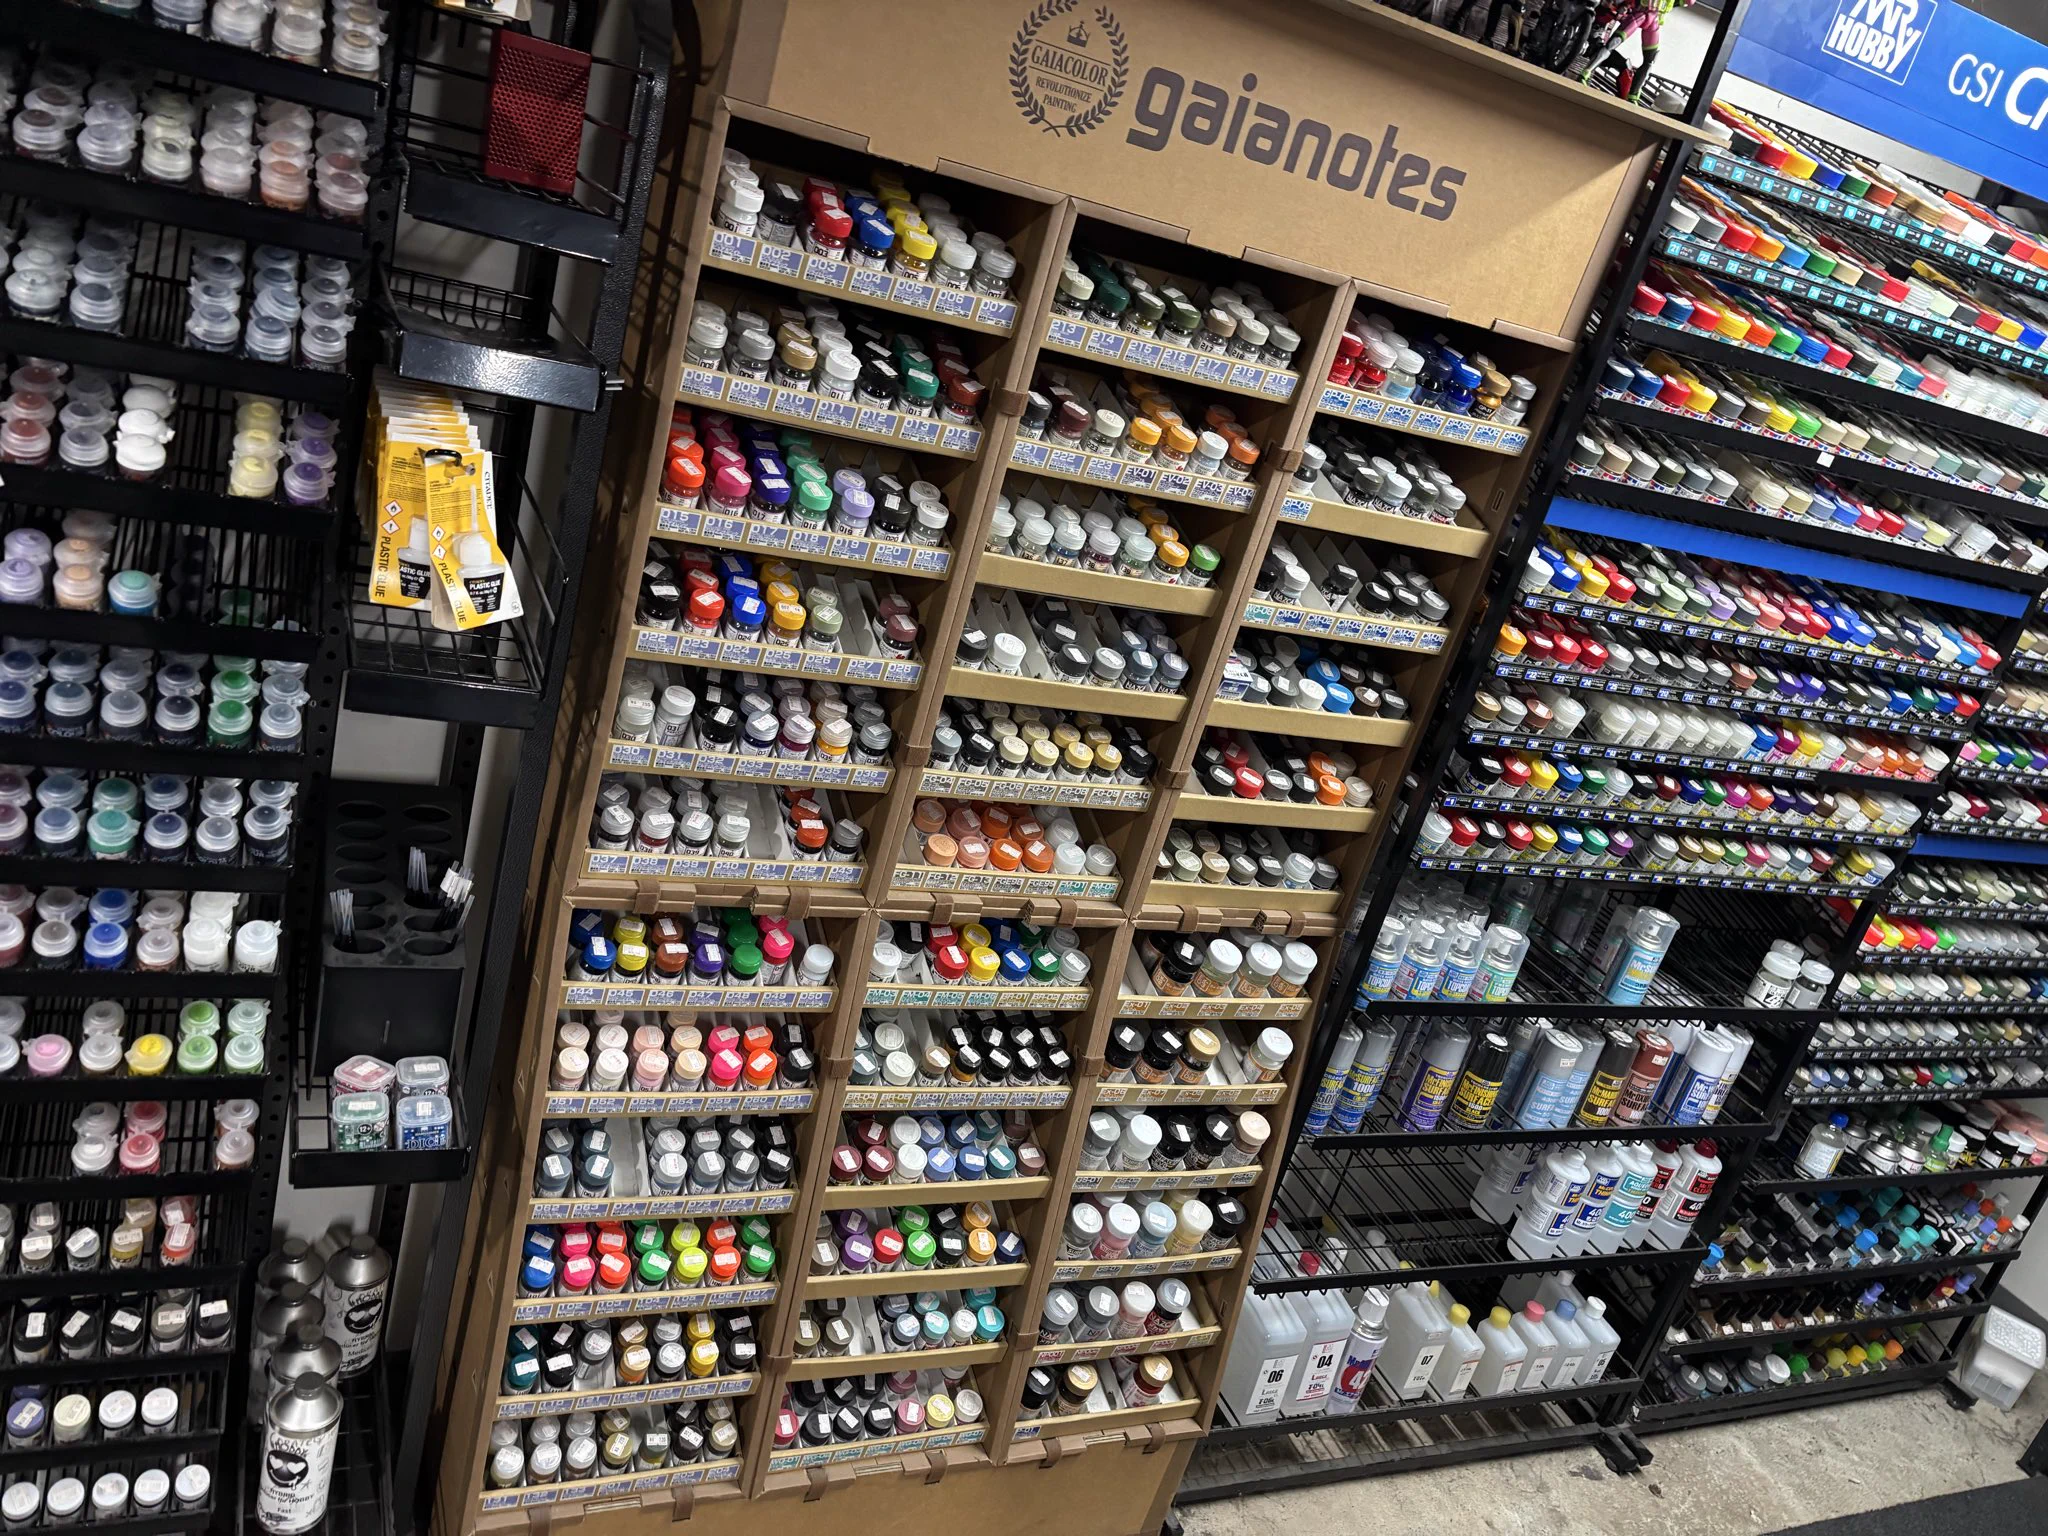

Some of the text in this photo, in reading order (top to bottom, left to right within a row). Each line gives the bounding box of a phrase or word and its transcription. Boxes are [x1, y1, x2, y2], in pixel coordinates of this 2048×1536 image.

[1826, 14, 1922, 74] HOBBY
[1031, 45, 1109, 87] GAIACOLOR
[1947, 53, 2005, 108] GSI
[1035, 76, 1093, 103] REVOLUTIONIZE
[1042, 94, 1078, 113] PAINTING
[1126, 66, 1467, 222] gaianotes
[714, 231, 740, 248] 001
[762, 244, 790, 260] 002
[810, 257, 837, 272] 003
[855, 270, 881, 284] 004
[899, 280, 925, 293] 005
[941, 290, 964, 304] 006
[982, 300, 1005, 313] 007
[1054, 321, 1075, 333] 213
[1126, 324, 1139, 334] 215
[1093, 332, 1114, 344] 214
[1131, 342, 1152, 353] 215
[1201, 343, 1214, 352] 217
[1165, 350, 1186, 362] 216
[1231, 350, 1244, 360] 218
[1200, 359, 1220, 370] 217
[684, 368, 711, 383] 008
[1235, 367, 1254, 377] 218
[1269, 375, 1287, 385] 219
[732, 381, 758, 394] 009
[777, 392, 805, 405] 010
[820, 402, 845, 412] 011
[907, 406, 922, 417] 013
[860, 410, 886, 422] 012
[904, 419, 928, 430] 013
[946, 426, 969, 438] 014
[1016, 443, 1037, 454] 221
[1087, 441, 1099, 453] 223
[1053, 452, 1075, 462] 222
[1091, 459, 1111, 469] 223
[661, 509, 688, 521] 015
[705, 517, 733, 529] 016
[751, 524, 777, 536] 017
[793, 531, 818, 542] 018
[834, 538, 859, 549] 019
[876, 545, 901, 555] 020
[916, 550, 940, 559] 021
[375, 536, 391, 598] PLASTIC GLUE
[469, 582, 490, 590] PLASTIC
[453, 600, 466, 623] GLUE
[640, 632, 667, 643] 022
[682, 640, 708, 649] 023
[723, 645, 749, 654] 024
[765, 650, 790, 660] 025
[806, 655, 830, 664] 026
[850, 660, 874, 669] 027
[888, 664, 912, 673] 028
[615, 746, 639, 755] 030
[656, 750, 681, 759] 031
[700, 756, 724, 764] 032
[740, 760, 764, 769] 033
[779, 764, 802, 773] 034
[817, 767, 842, 775] 035
[592, 856, 616, 864] 037
[632, 856, 658, 865] 038
[674, 860, 698, 868] 039
[1317, 1355, 1333, 1368] 04
[1421, 1355, 1433, 1365] 07
[1267, 1370, 1284, 1383] 06
